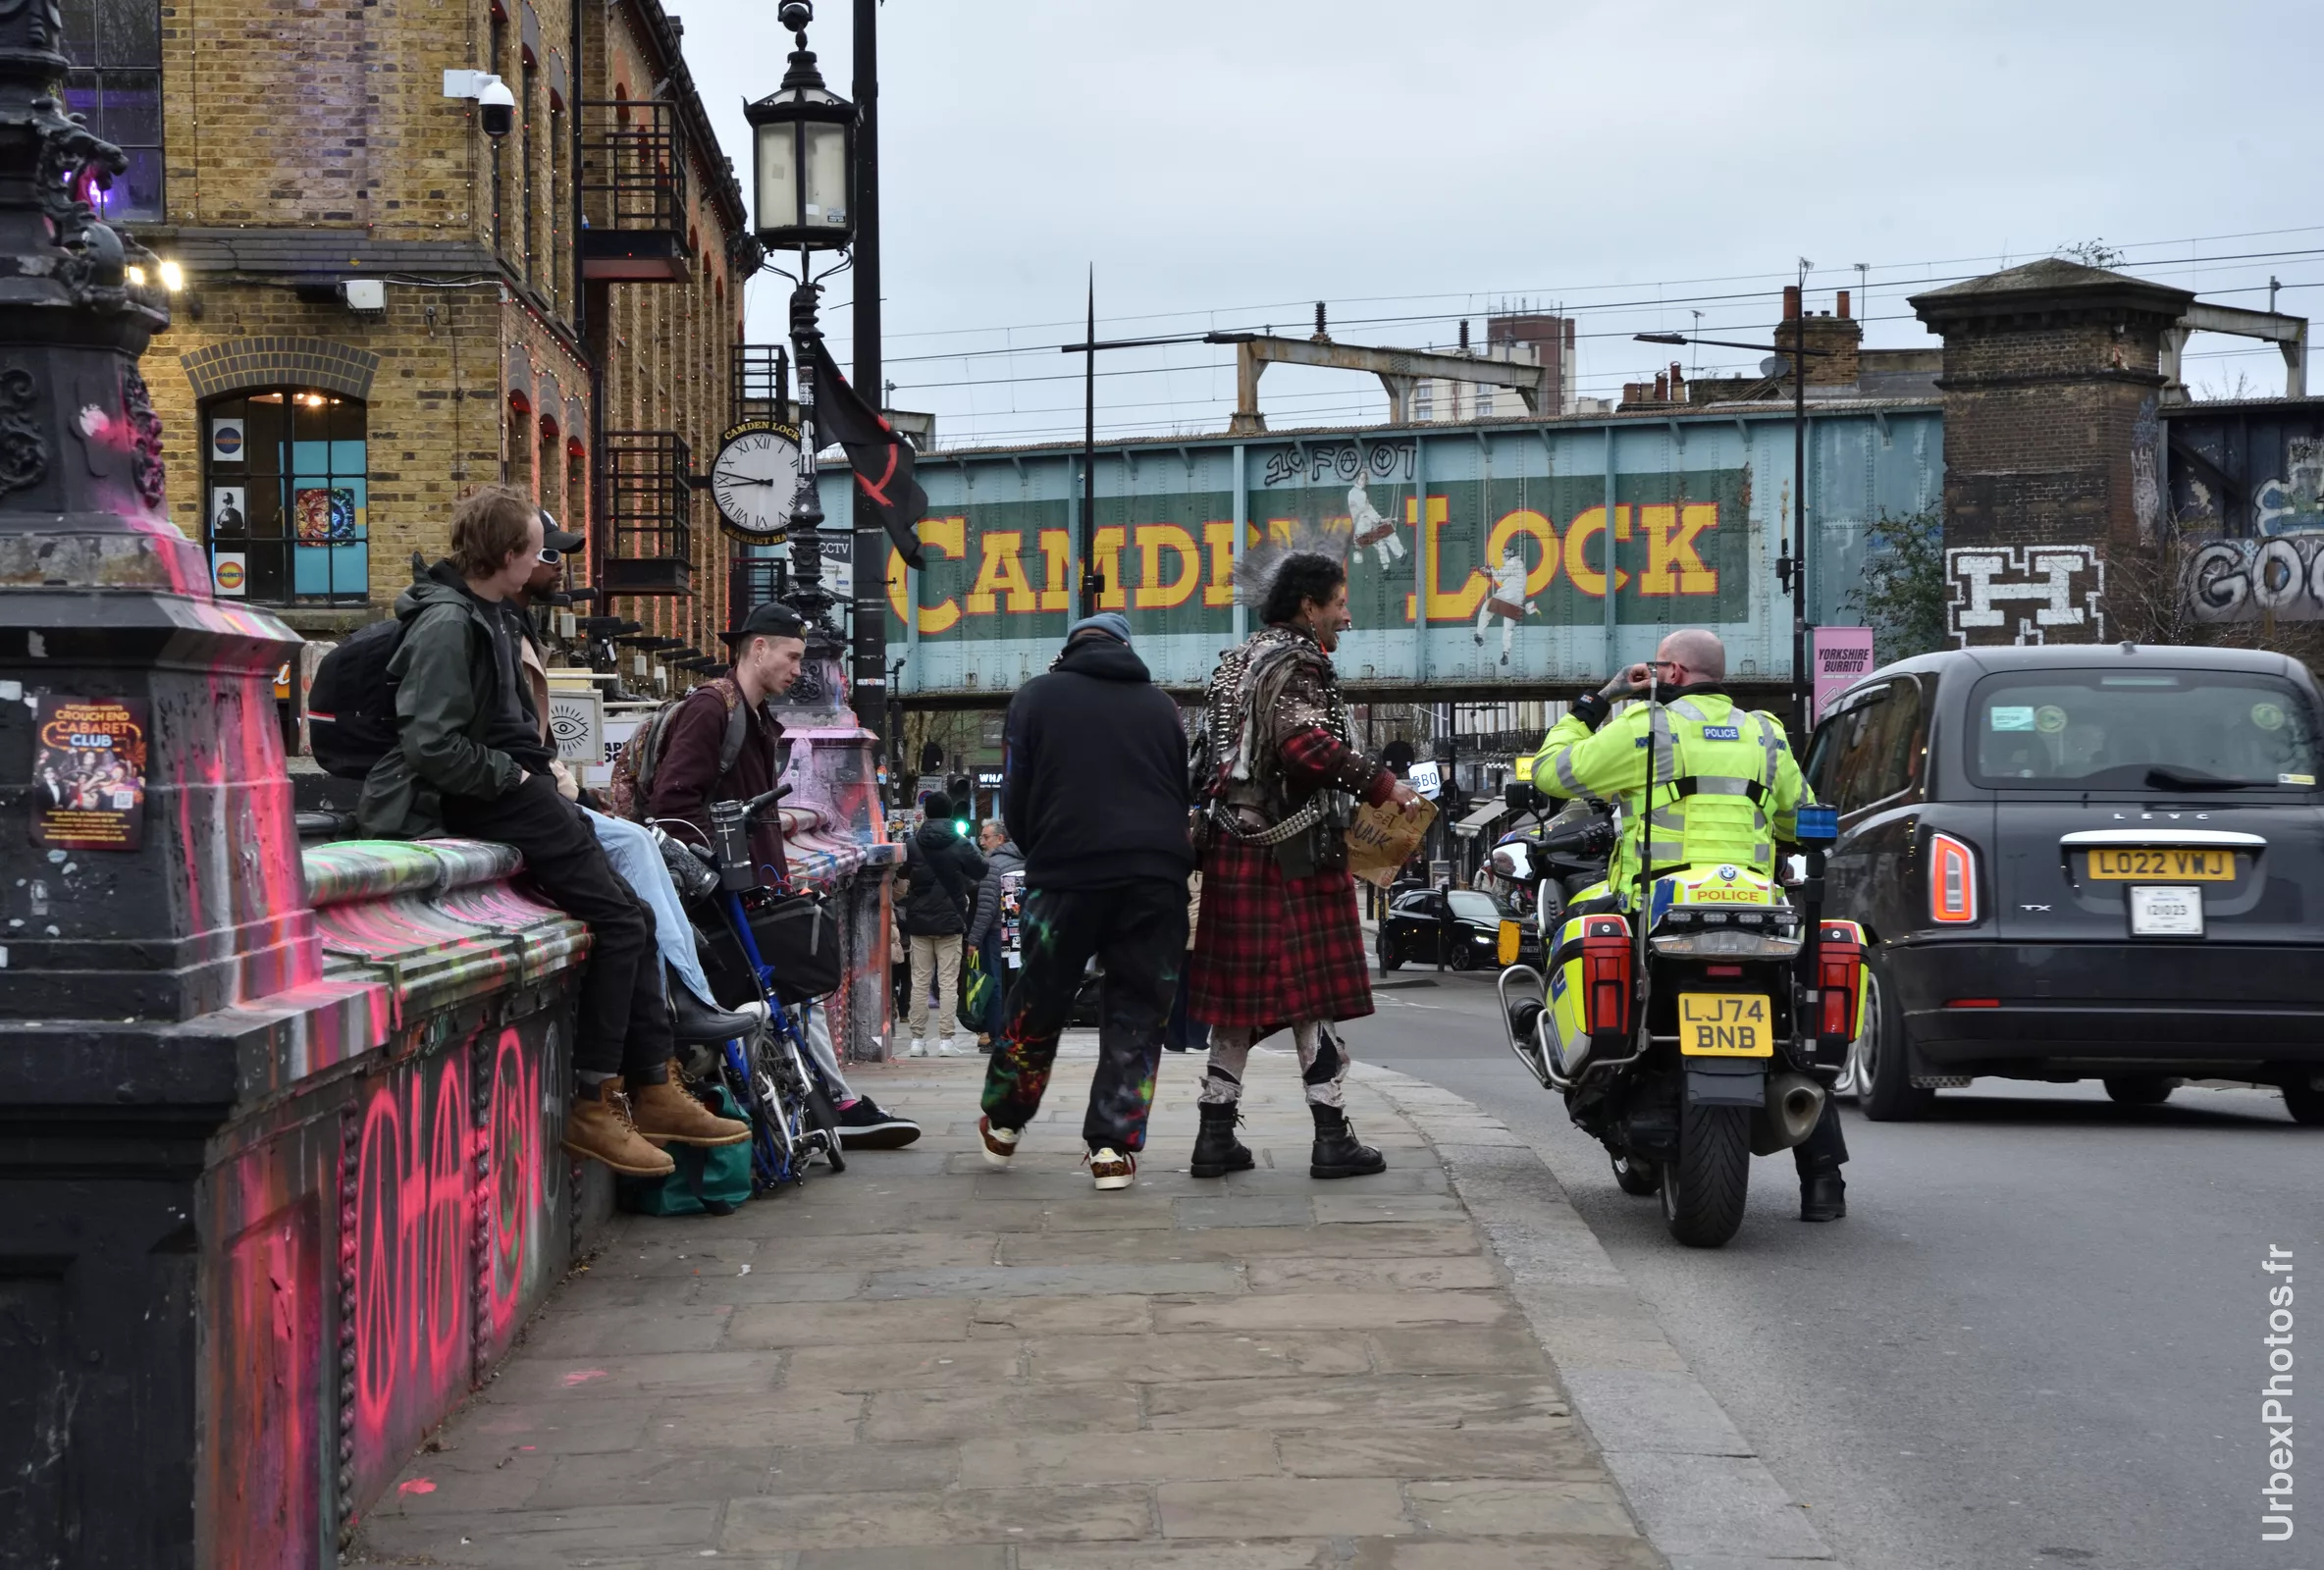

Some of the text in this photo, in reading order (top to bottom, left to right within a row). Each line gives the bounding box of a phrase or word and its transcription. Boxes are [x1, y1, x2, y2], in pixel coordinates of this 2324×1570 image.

[724, 421, 800, 441] CAMDEN LOCK
[724, 526, 787, 545] MARKET HA
[819, 543, 849, 554] CCTV
[1405, 495, 1719, 623] LOCK
[1819, 649, 1870, 660] YORKSHIRE
[1824, 660, 1864, 672] BURRITO
[55, 709, 131, 721] CROUCH END
[55, 721, 130, 734] CABARET
[1705, 727, 1738, 738] POLICE
[70, 734, 113, 748] CLUB
[2098, 852, 2224, 875] LO22 VWJ
[1697, 890, 1759, 902] POLICE
[1684, 999, 1765, 1022] LJ74
[1696, 1024, 1756, 1049] BNB
